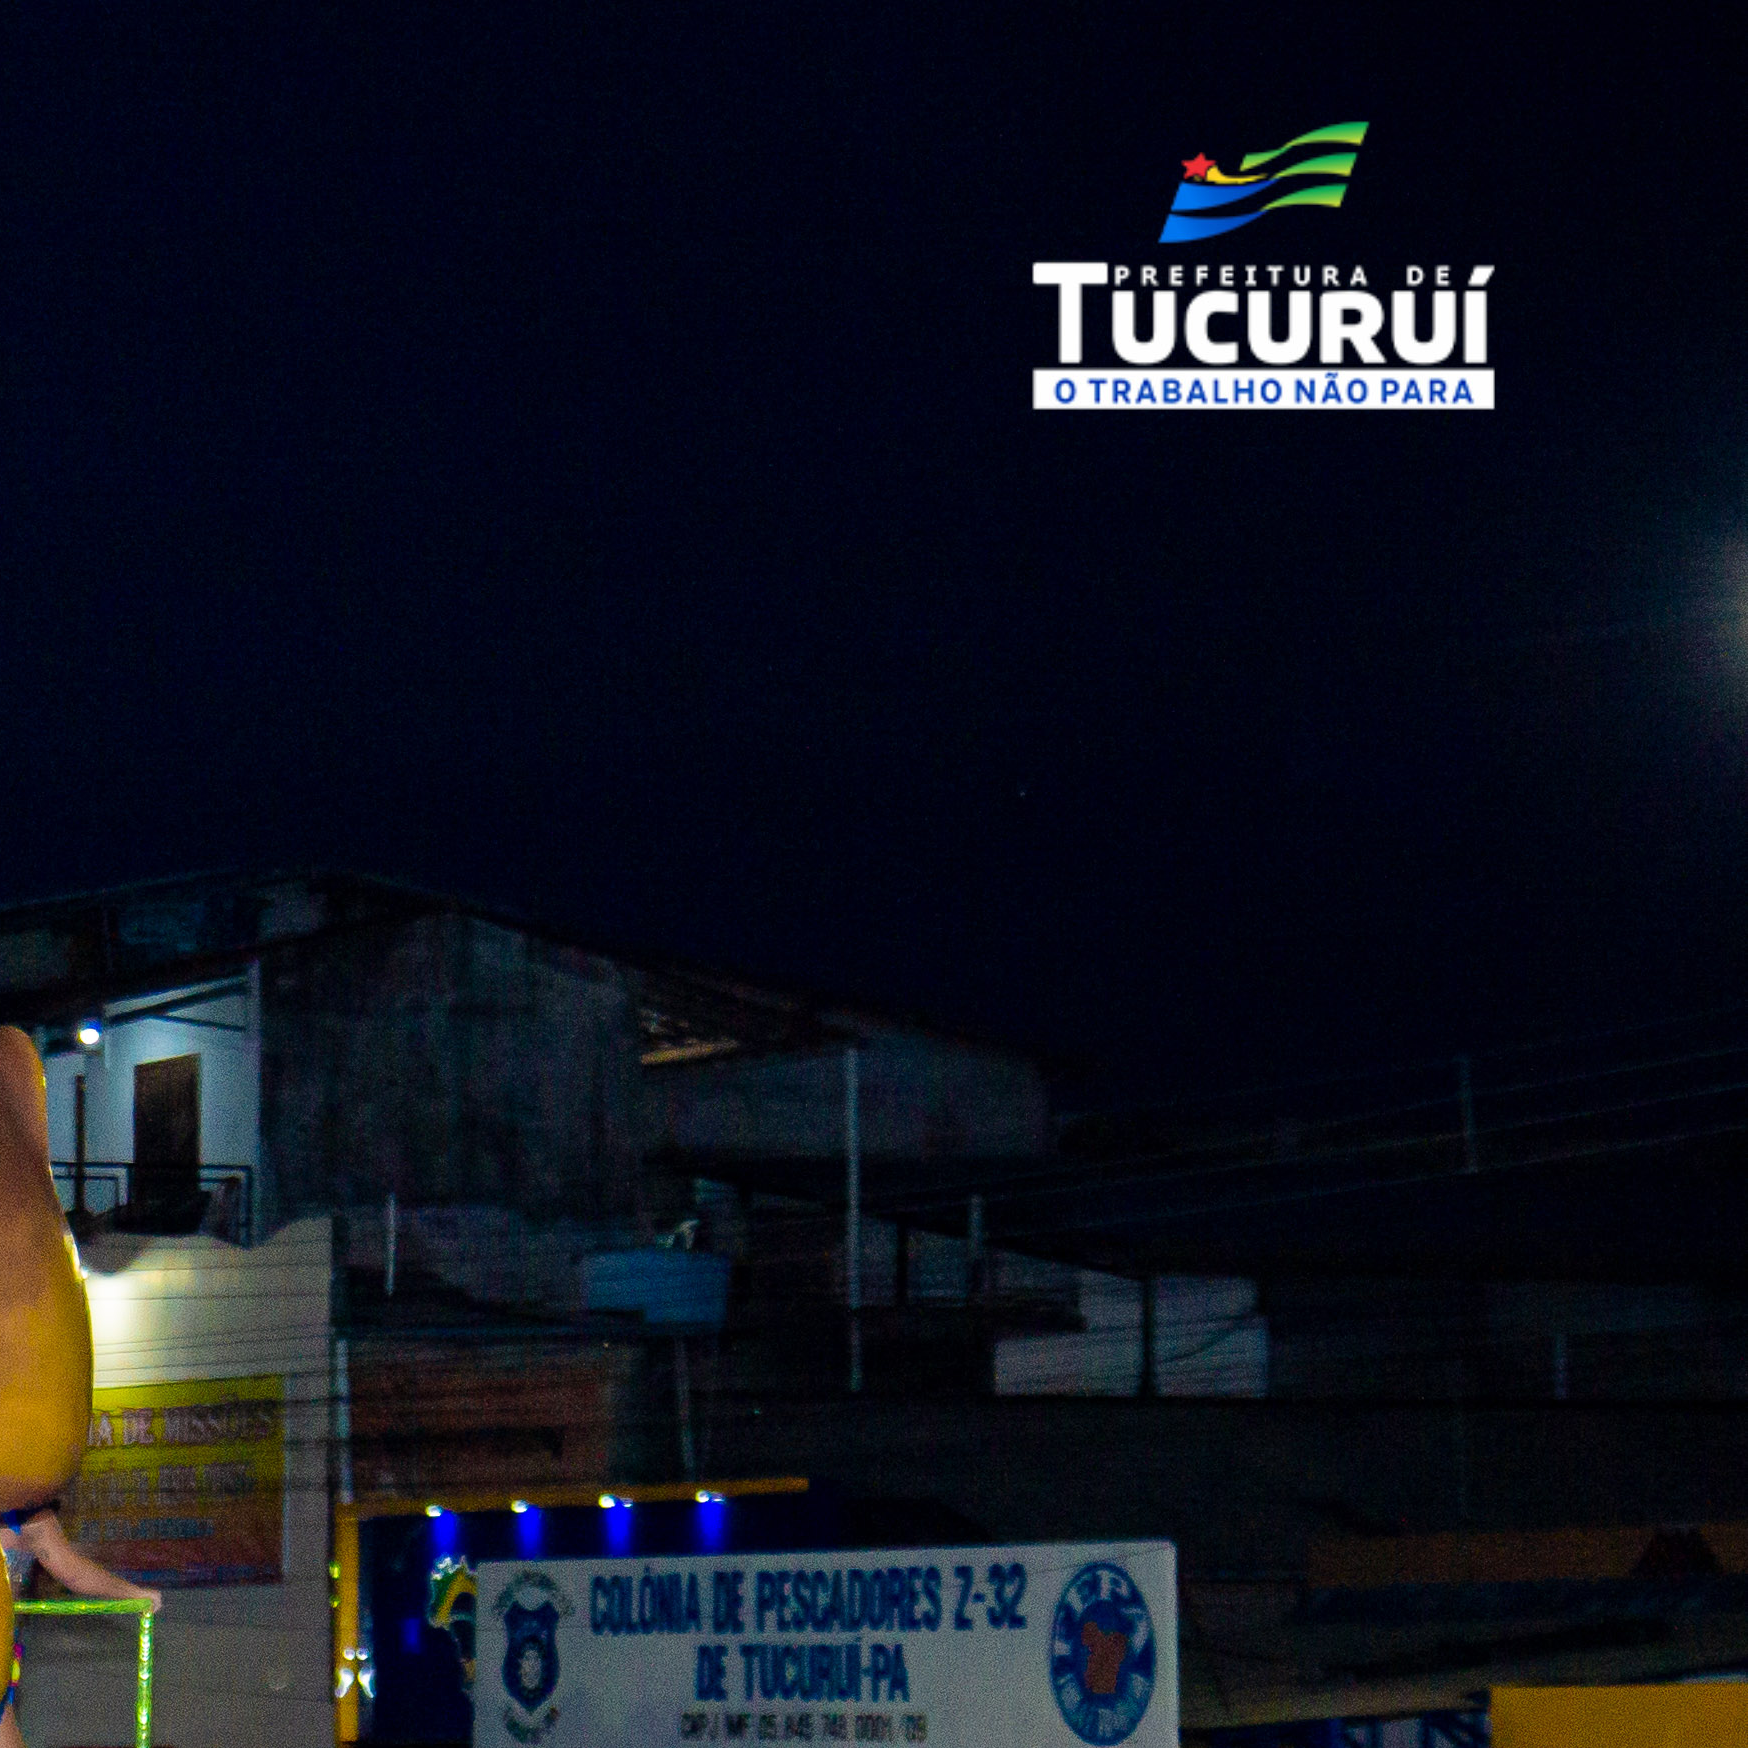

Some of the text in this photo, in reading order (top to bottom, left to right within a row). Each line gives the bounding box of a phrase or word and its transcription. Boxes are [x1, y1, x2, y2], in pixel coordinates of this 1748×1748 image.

[712, 1570, 745, 1634] DE
[755, 1566, 943, 1634] PESCADORES
[953, 1563, 1028, 1630] Z-32
[695, 1645, 728, 1702] DE
